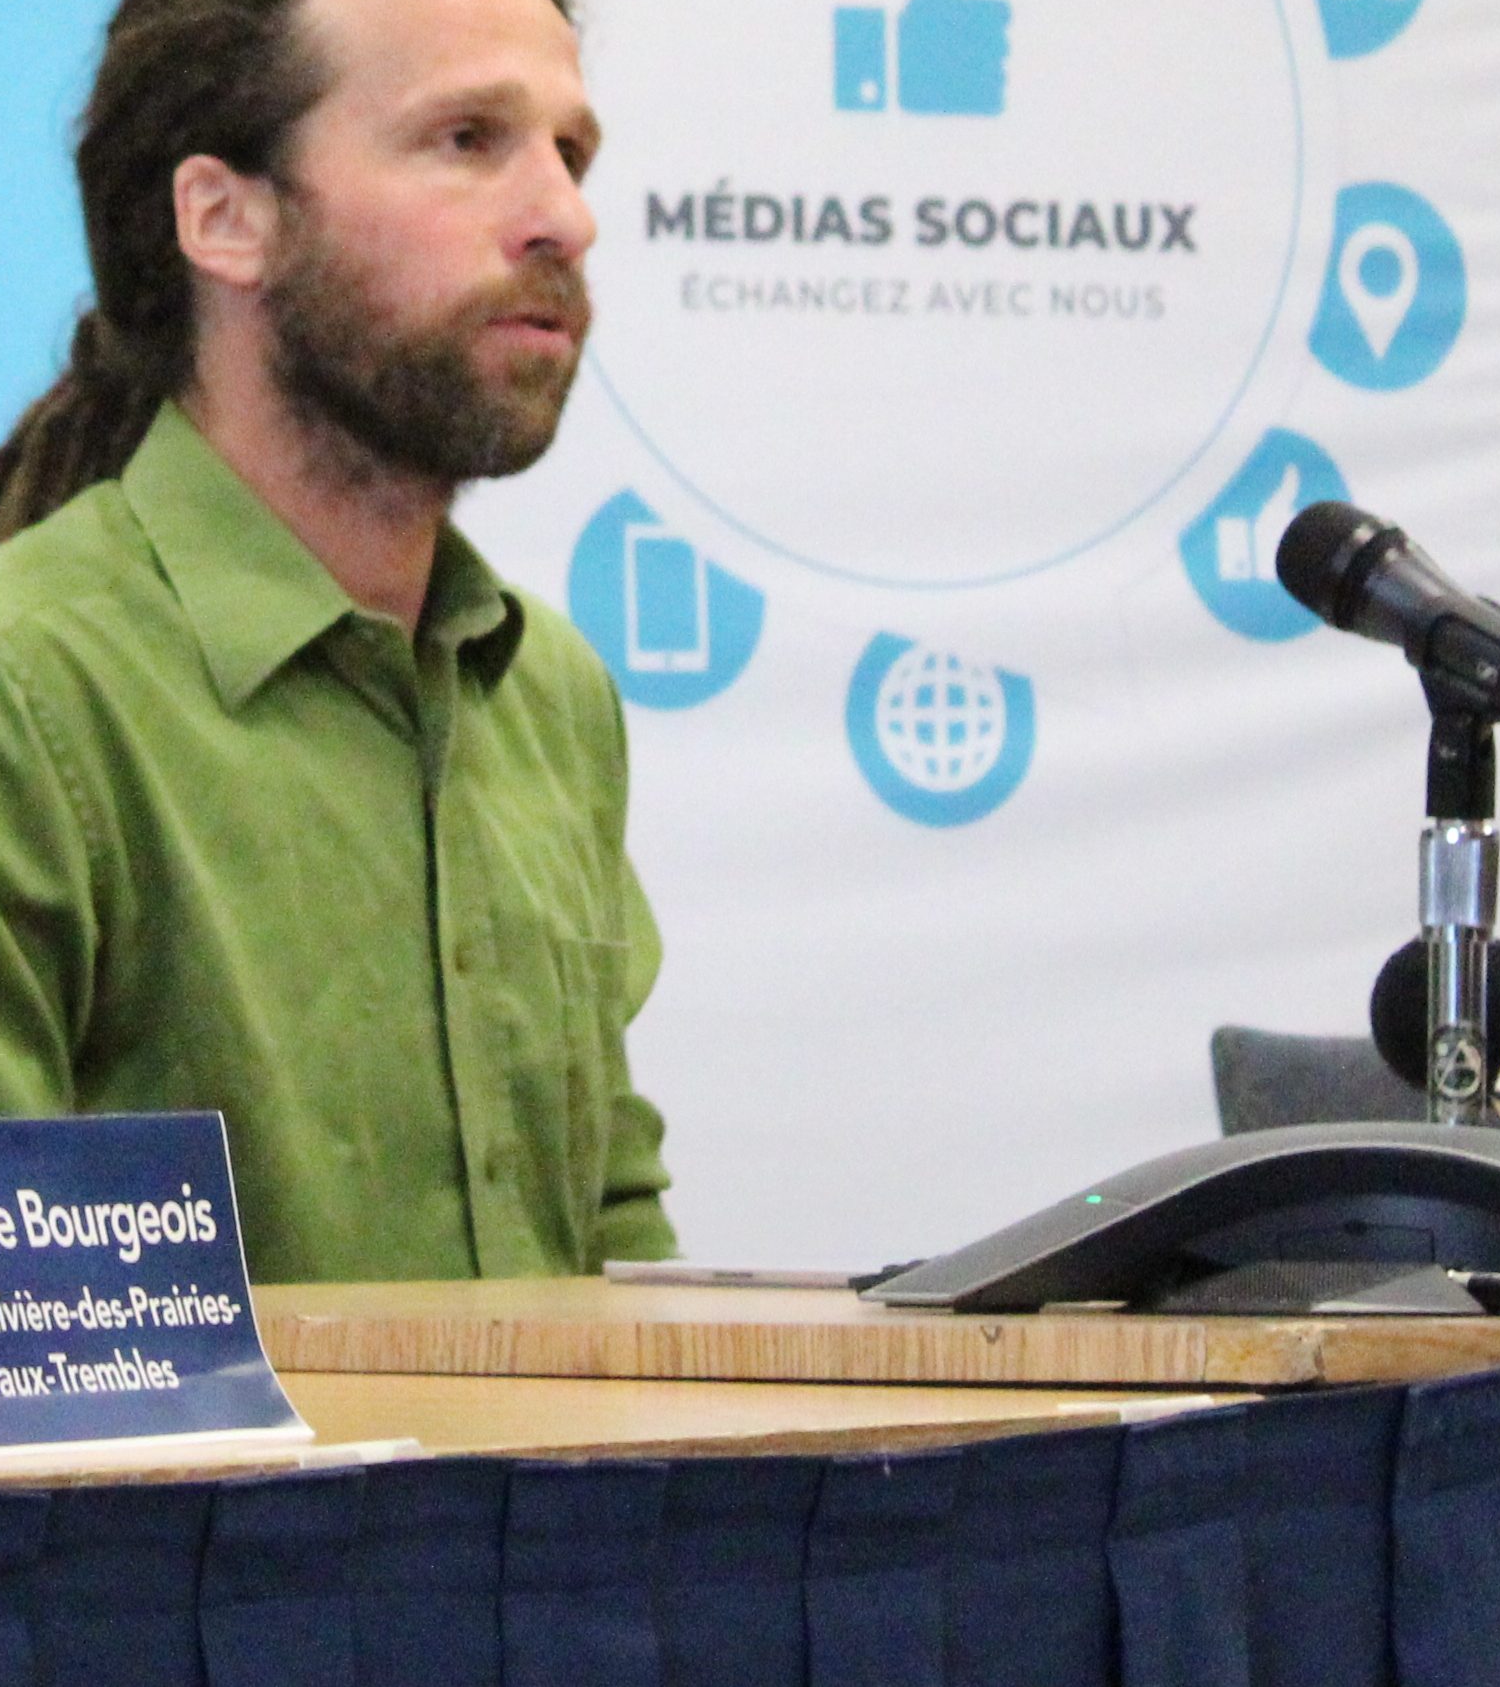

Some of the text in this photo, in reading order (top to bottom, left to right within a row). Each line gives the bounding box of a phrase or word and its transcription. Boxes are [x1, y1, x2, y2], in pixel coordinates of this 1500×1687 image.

[646, 177, 1197, 252] MÉDIAS SOCIAUX
[680, 270, 1167, 319] ÉCHANGEZ AVEC NOUS
[15, 1183, 217, 1264] Bourgeois
